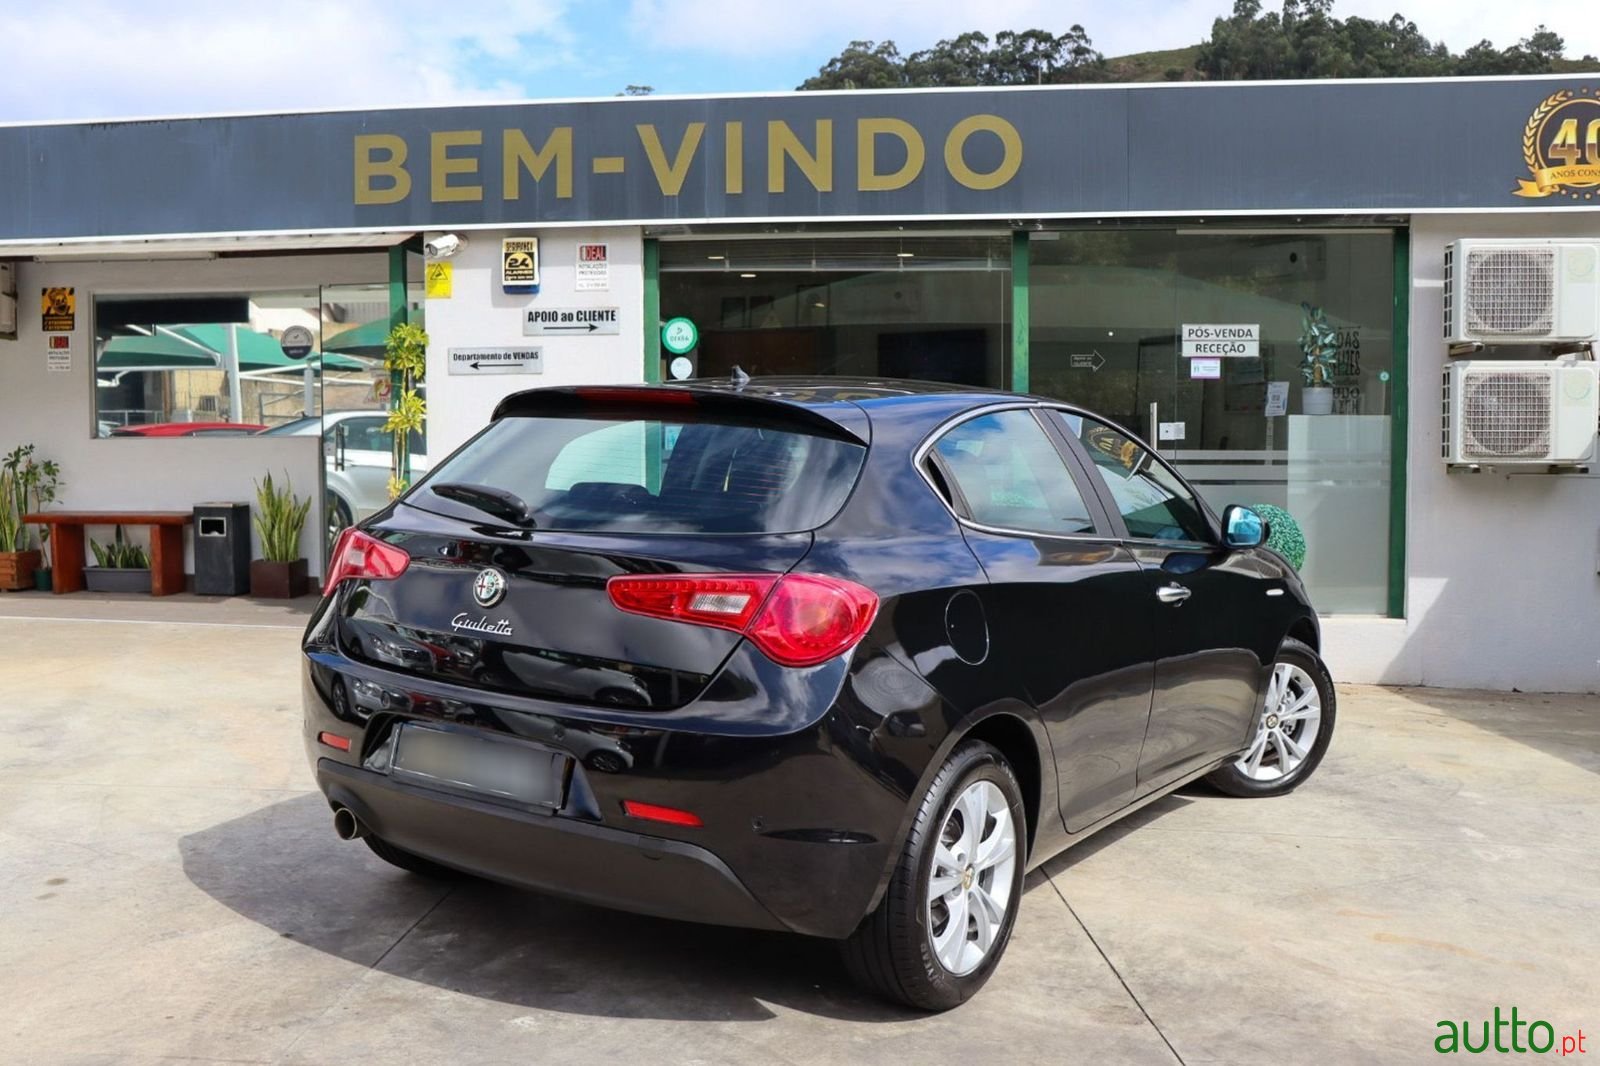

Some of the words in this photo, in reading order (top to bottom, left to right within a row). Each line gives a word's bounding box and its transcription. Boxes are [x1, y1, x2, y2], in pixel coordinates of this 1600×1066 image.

[354, 115, 1023, 205] BEM-VINDO
[1551, 169, 1575, 179] ANOS
[527, 311, 558, 322] APOIO
[560, 312, 574, 322] ao
[576, 310, 616, 322] CLIENTE
[1188, 326, 1253, 338] PÓS-VENDA
[1195, 342, 1246, 355] RECEÇÃO
[453, 352, 502, 361] Departamento
[503, 352, 512, 360] de
[513, 351, 539, 360] VENDAS
[451, 613, 513, 636] Giulietta
